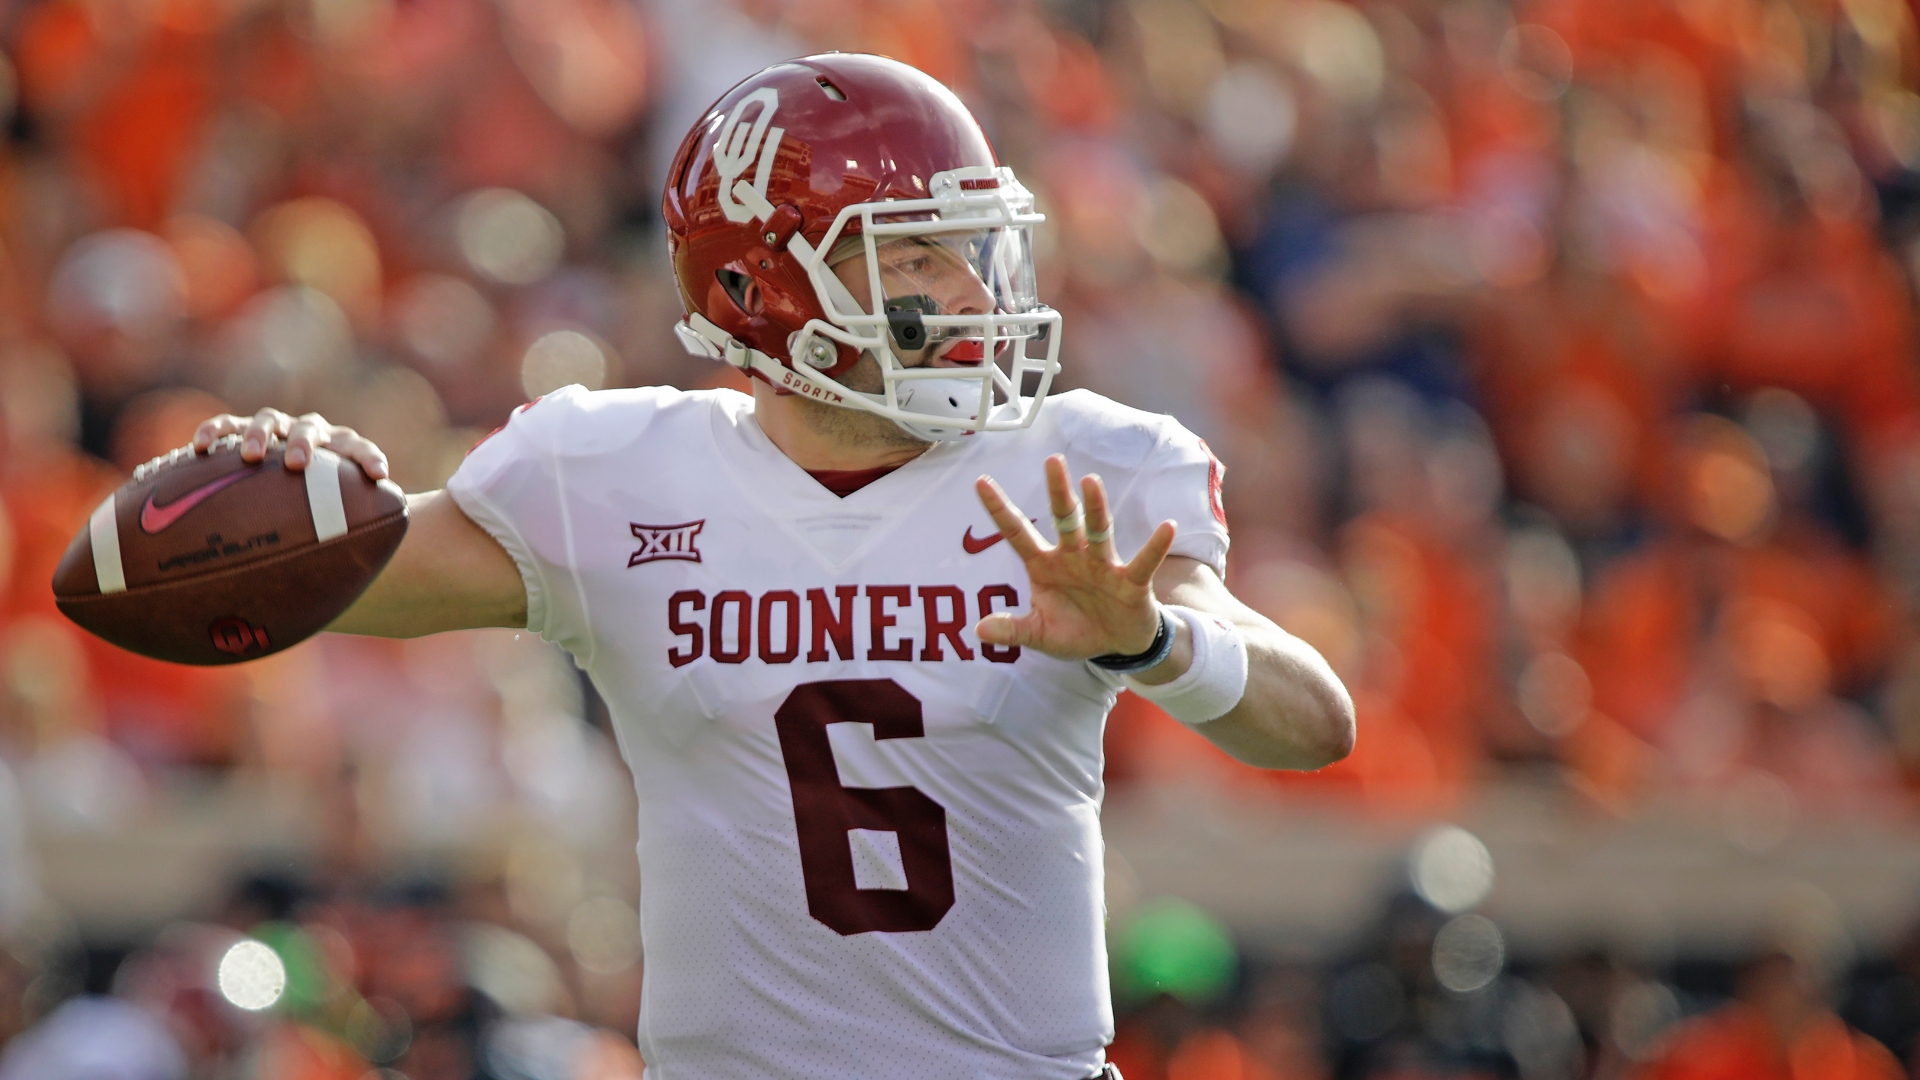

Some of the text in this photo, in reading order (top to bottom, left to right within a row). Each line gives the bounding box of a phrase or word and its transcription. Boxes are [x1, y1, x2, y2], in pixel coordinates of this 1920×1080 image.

[714, 87, 785, 223] OU
[783, 371, 832, 401] SPORT
[629, 520, 703, 565] XII
[774, 677, 956, 936] 6
